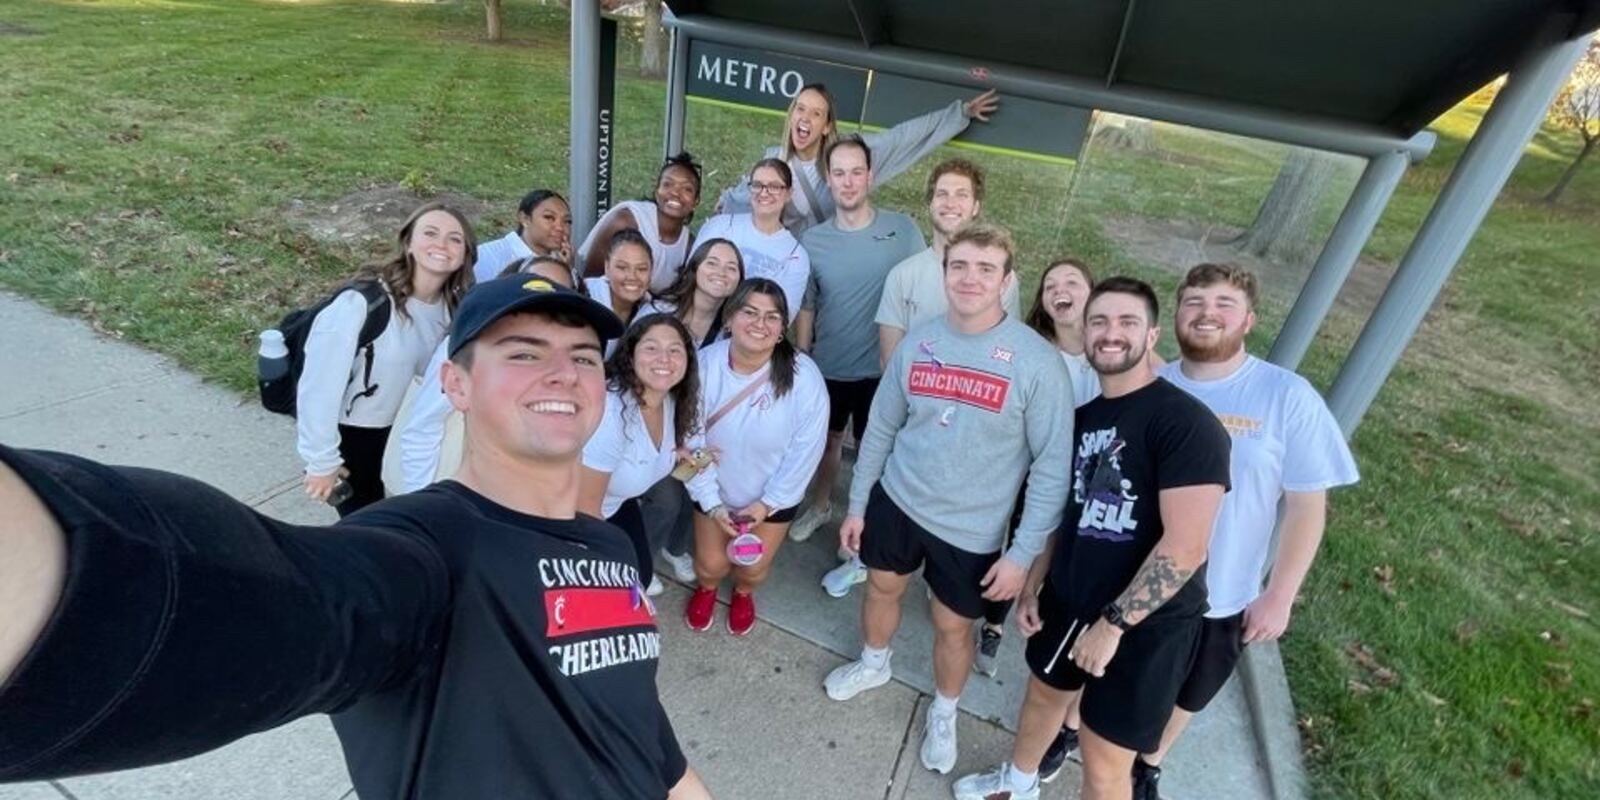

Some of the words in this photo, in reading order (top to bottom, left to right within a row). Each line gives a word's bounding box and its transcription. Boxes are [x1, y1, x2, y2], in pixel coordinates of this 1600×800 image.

[697, 54, 804, 98] METRO
[598, 109, 610, 192] UPTOWN
[910, 371, 1003, 403] CINCINNATI
